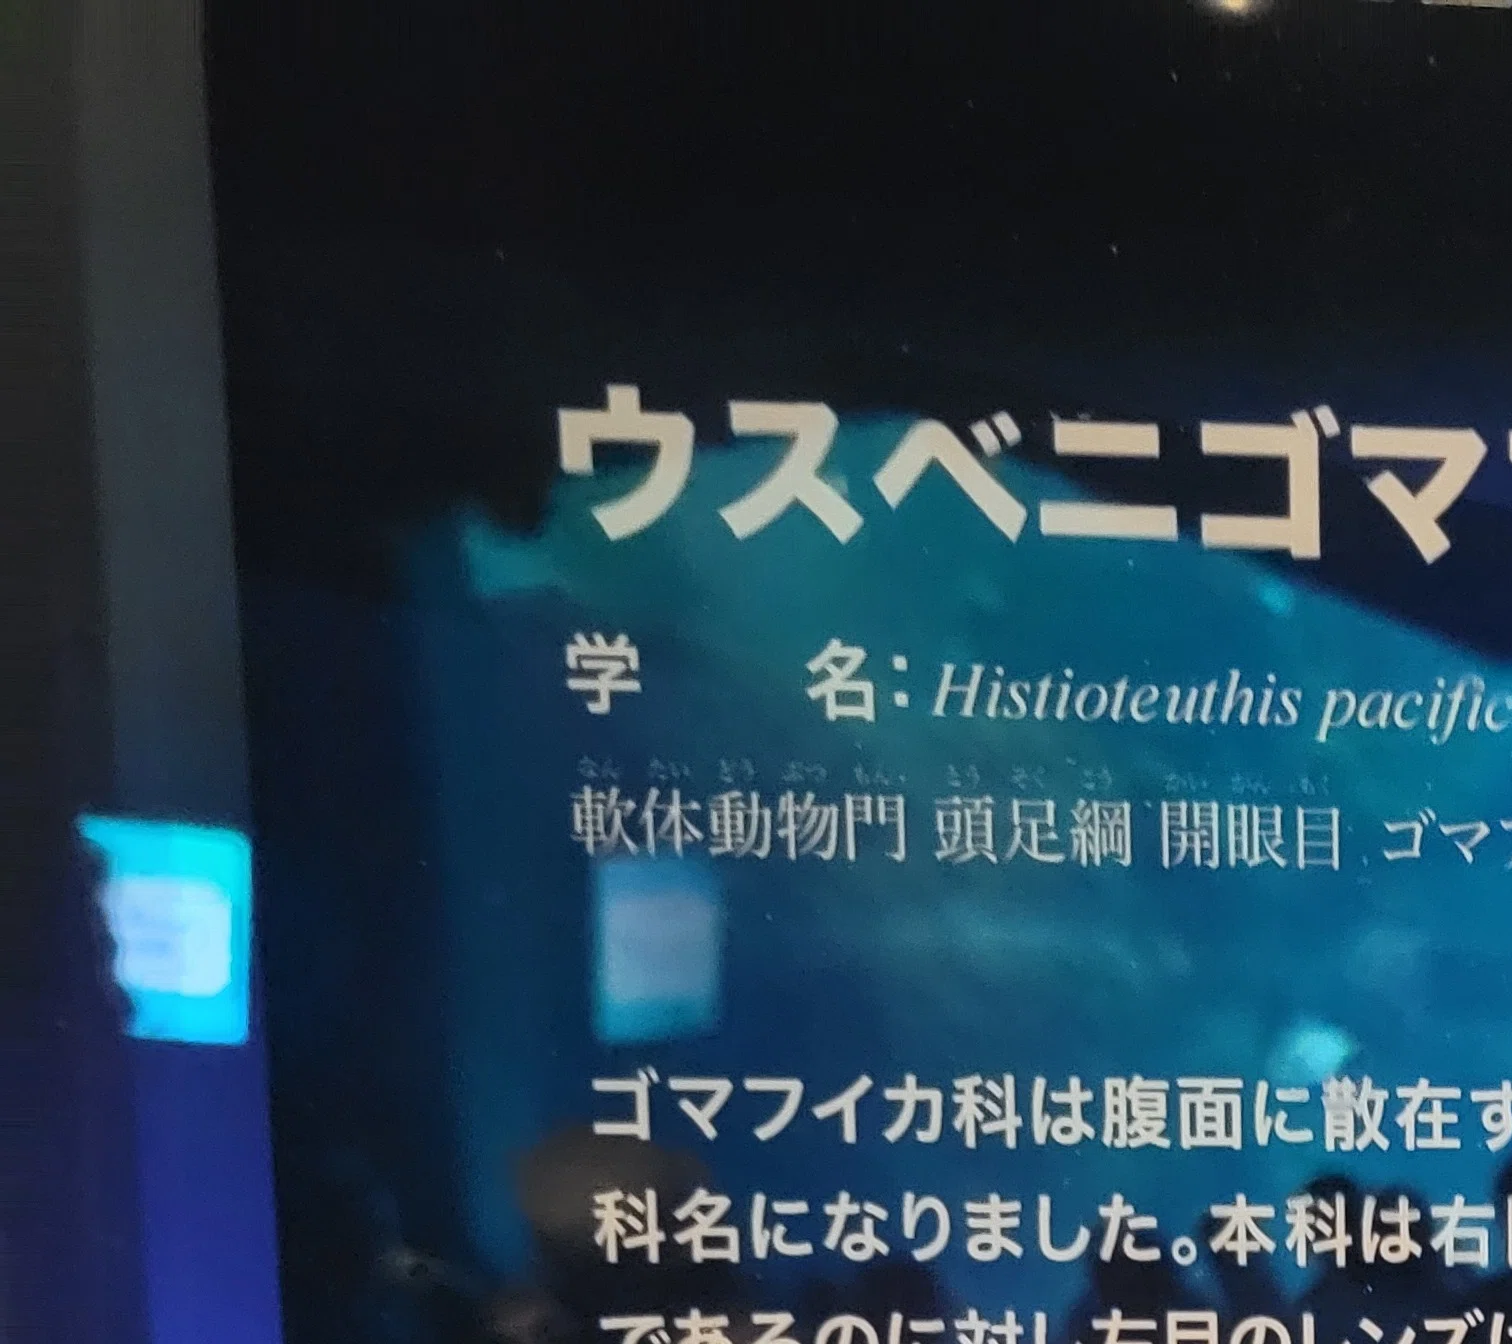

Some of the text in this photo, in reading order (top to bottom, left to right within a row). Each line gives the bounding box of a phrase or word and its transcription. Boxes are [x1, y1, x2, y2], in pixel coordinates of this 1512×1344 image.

[565, 632, 642, 714] 学
[932, 663, 1302, 727] Histioteuthis
[568, 783, 903, 862] 軟体動物門
[934, 796, 1132, 868] 頭足綱
[1160, 799, 1341, 871] 開眼目
